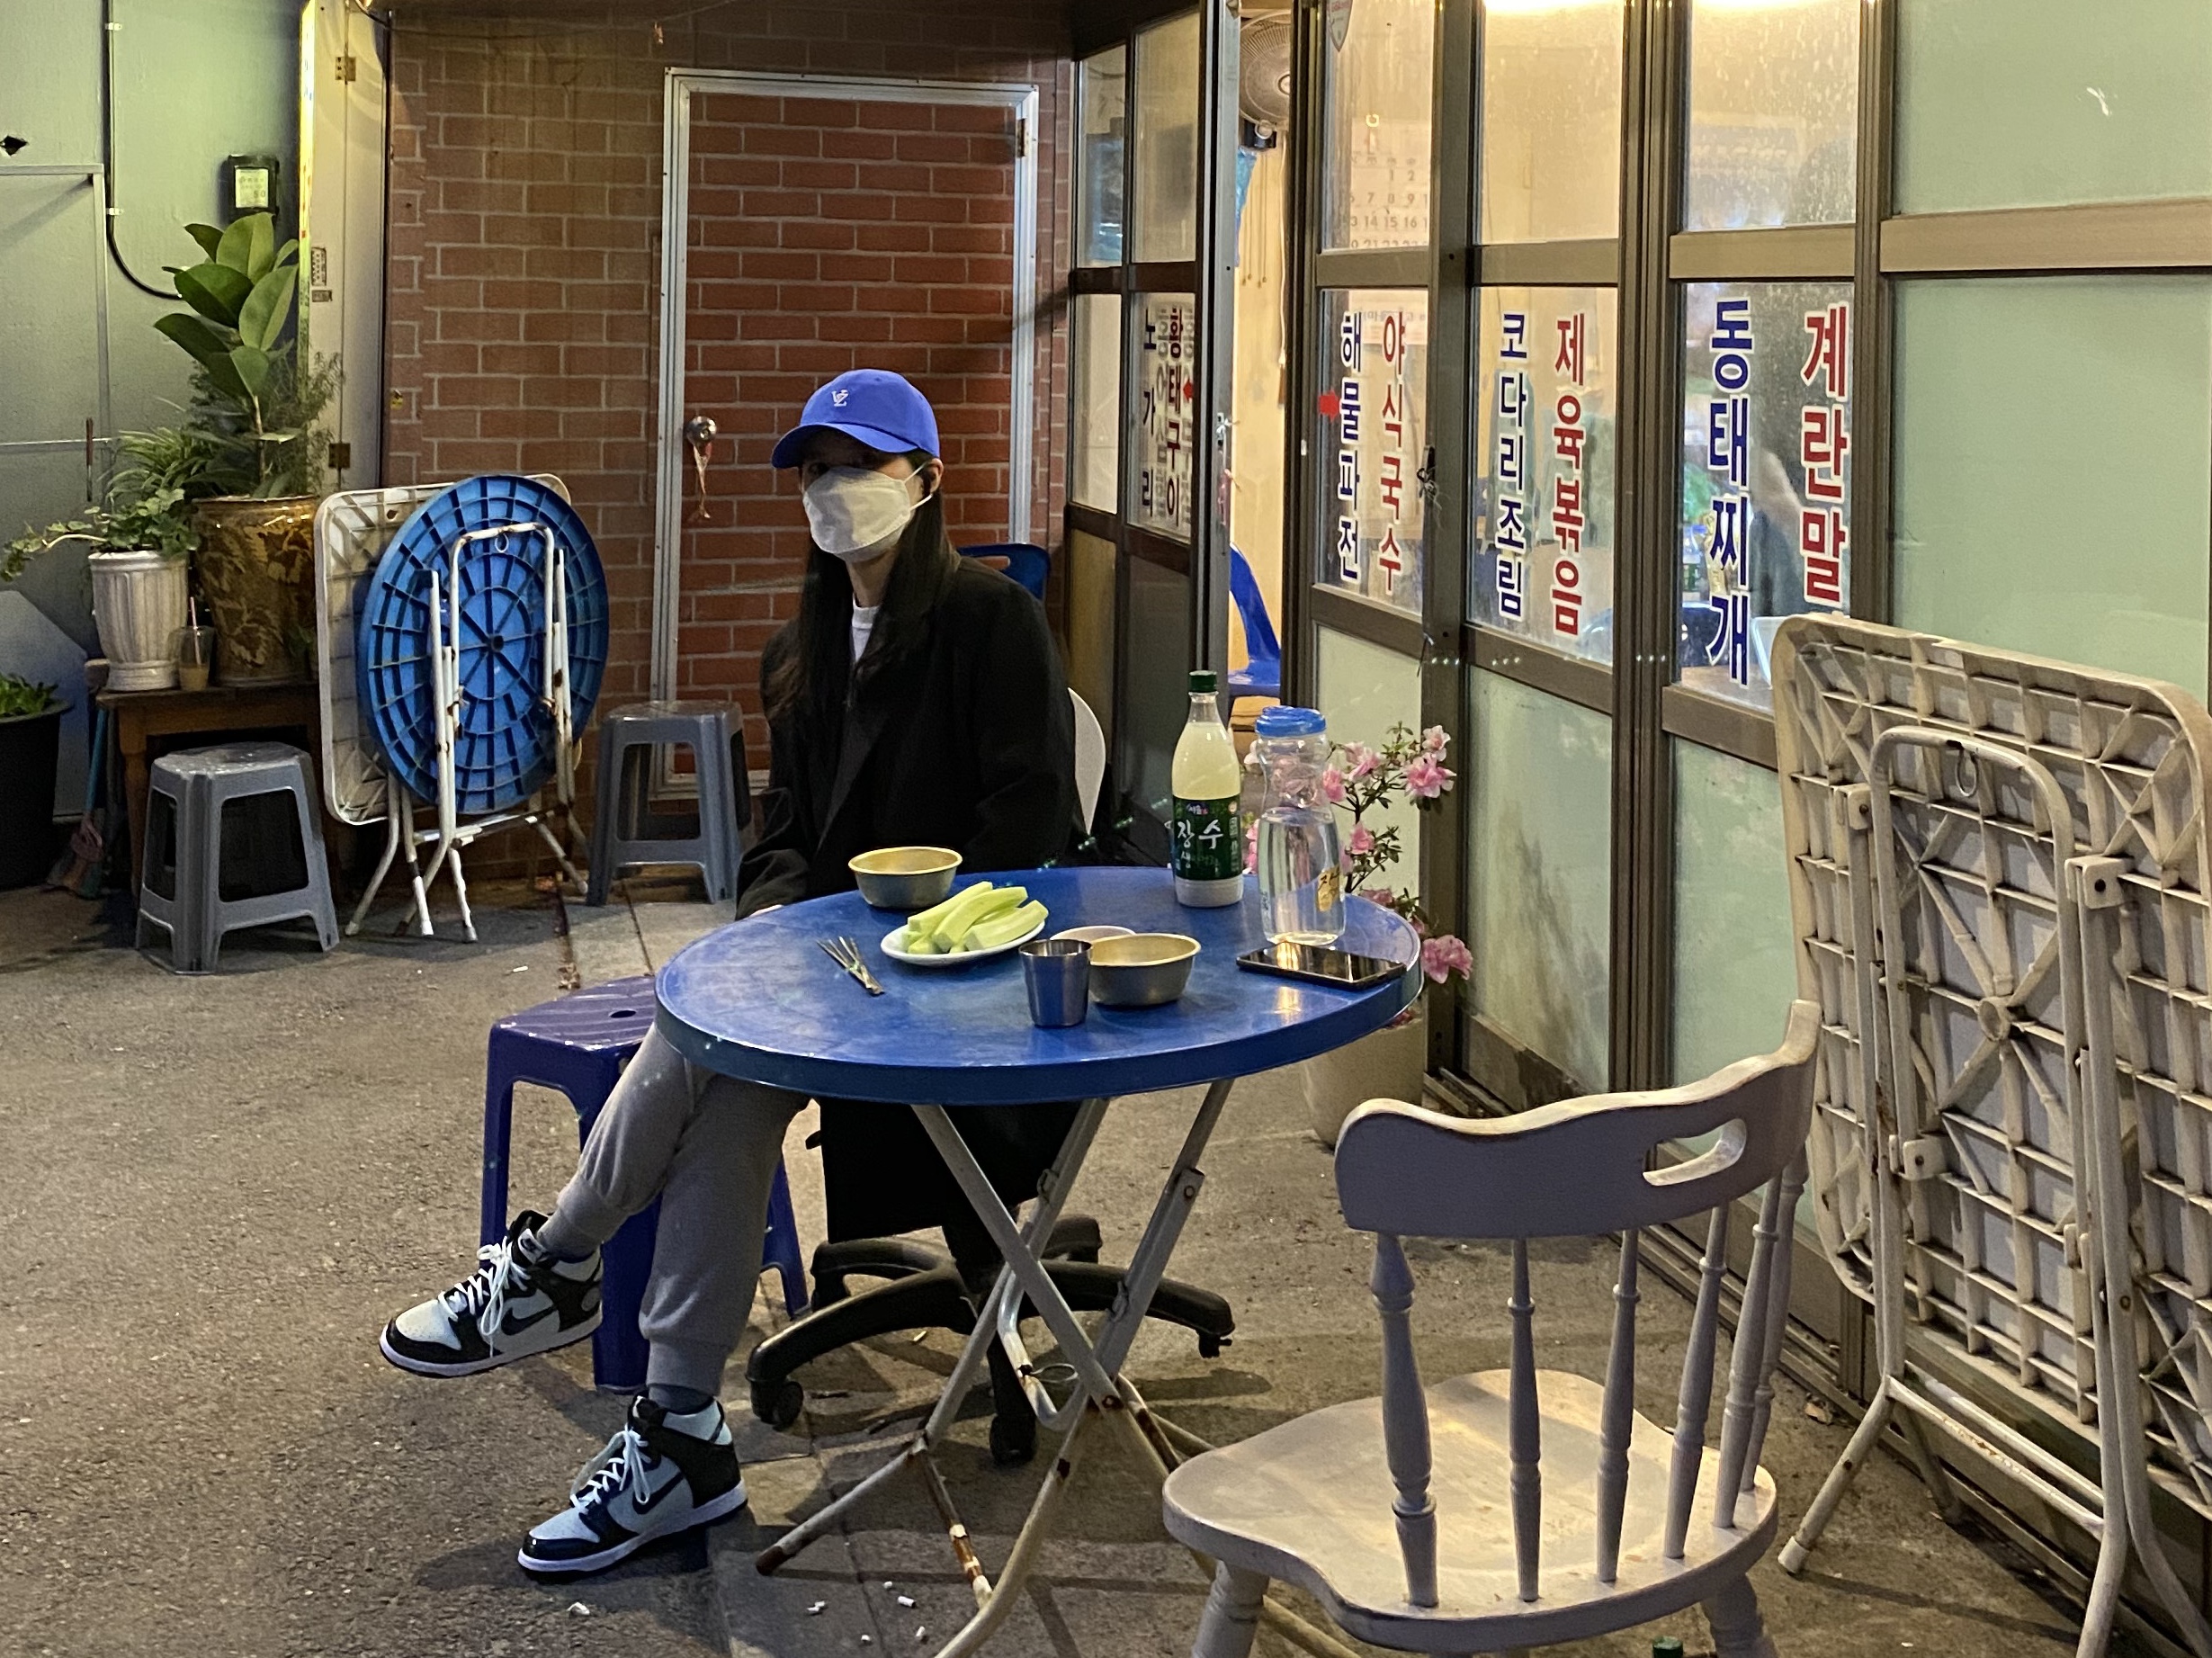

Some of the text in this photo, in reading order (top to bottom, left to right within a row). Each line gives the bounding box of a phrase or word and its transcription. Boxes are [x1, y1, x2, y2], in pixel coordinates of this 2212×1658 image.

[1142, 308, 1156, 516] 노가리
[1167, 308, 1183, 527] 황태구이
[1339, 312, 1362, 580] 해물파전
[1379, 311, 1405, 593] 야식국수
[1495, 313, 1527, 617] 코다리조림
[1551, 313, 1585, 636] 제육볶음
[1706, 300, 1752, 686] 동태찌개
[1178, 820, 1224, 849] 장수
